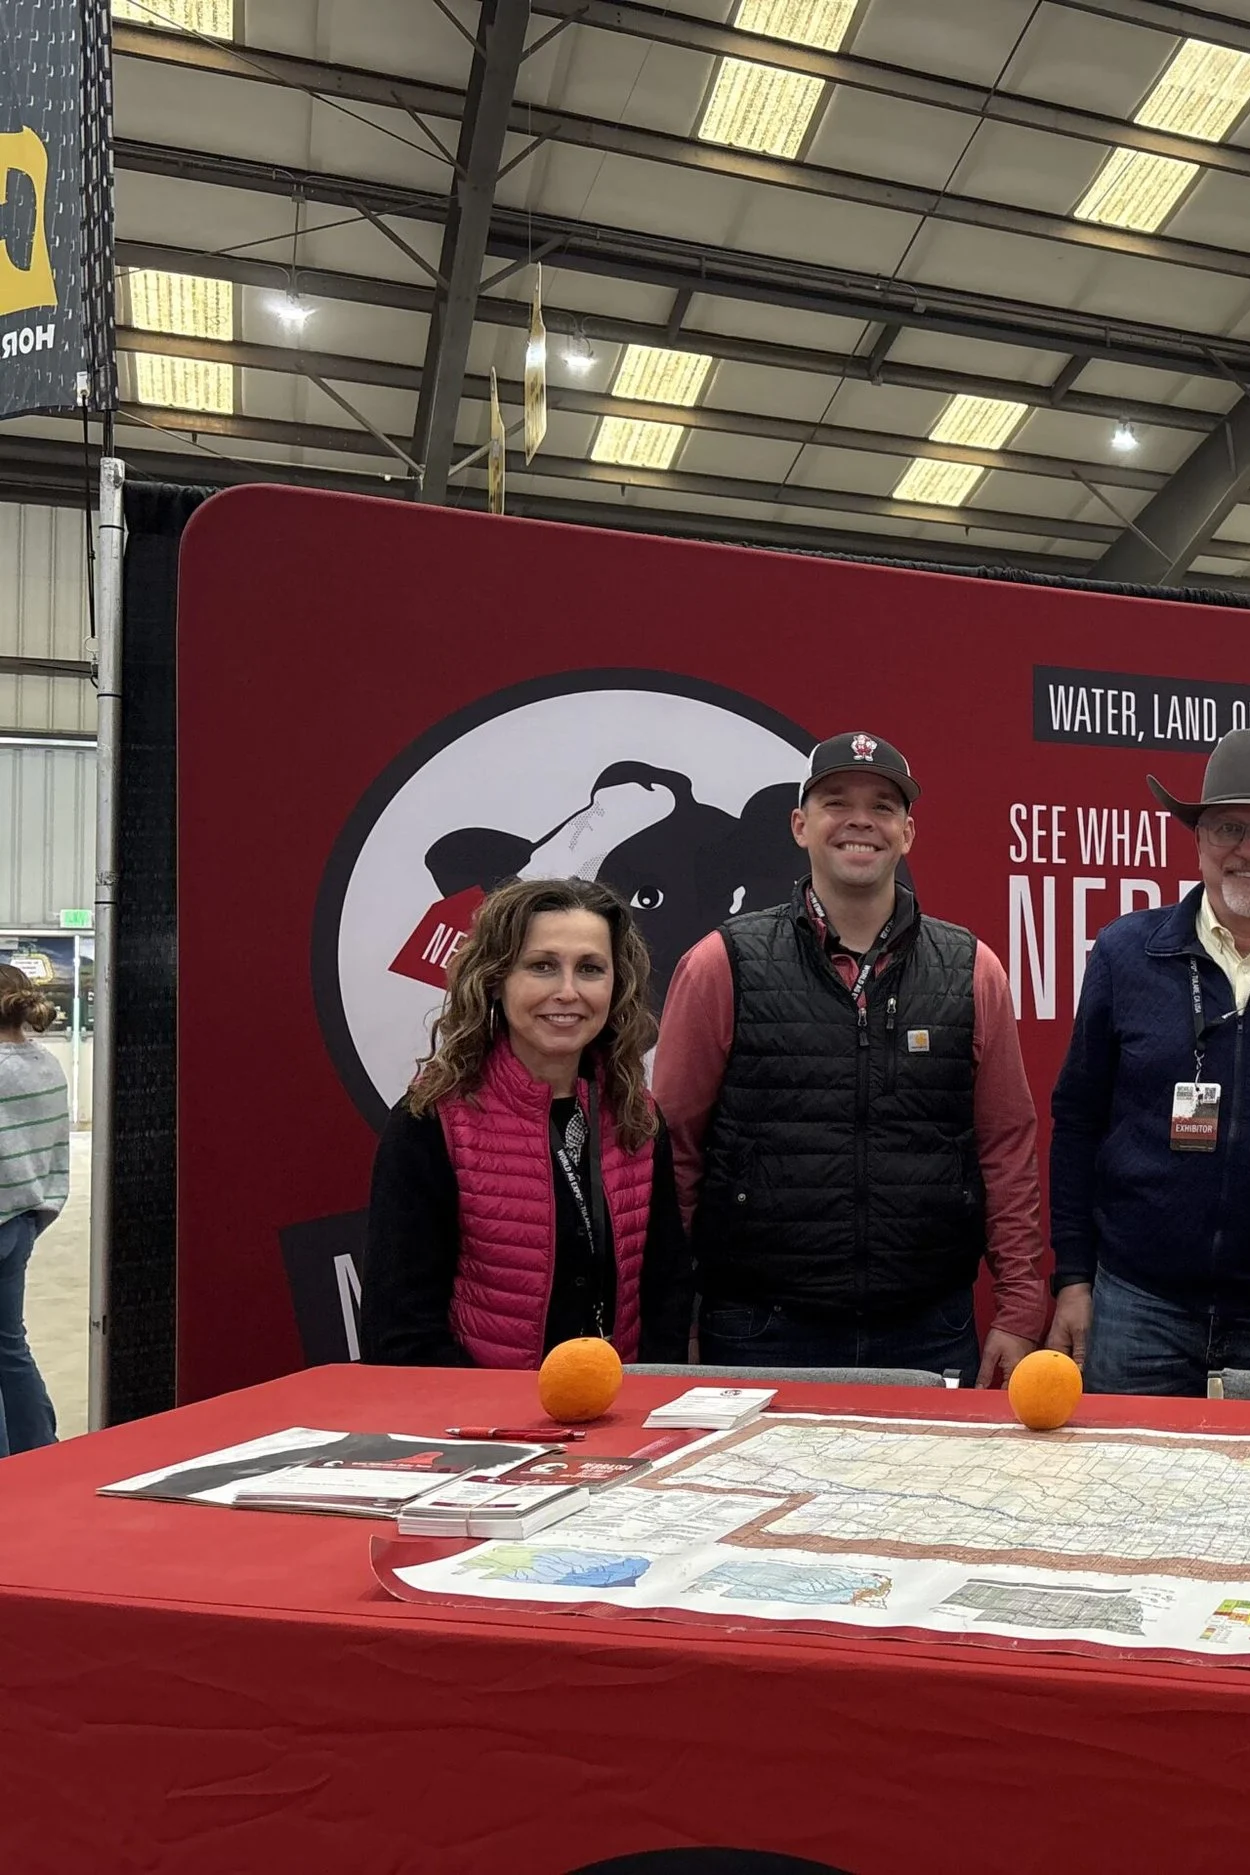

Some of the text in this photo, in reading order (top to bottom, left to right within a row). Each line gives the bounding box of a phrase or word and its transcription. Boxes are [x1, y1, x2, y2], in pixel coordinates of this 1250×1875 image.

[1048, 684, 1145, 742] WATER,
[1009, 803, 1171, 868] SEE WHAT
[1175, 1123, 1213, 1133] EXHIBITOR
[557, 1149, 571, 1172] WORLD
[566, 1172, 576, 1182] AG
